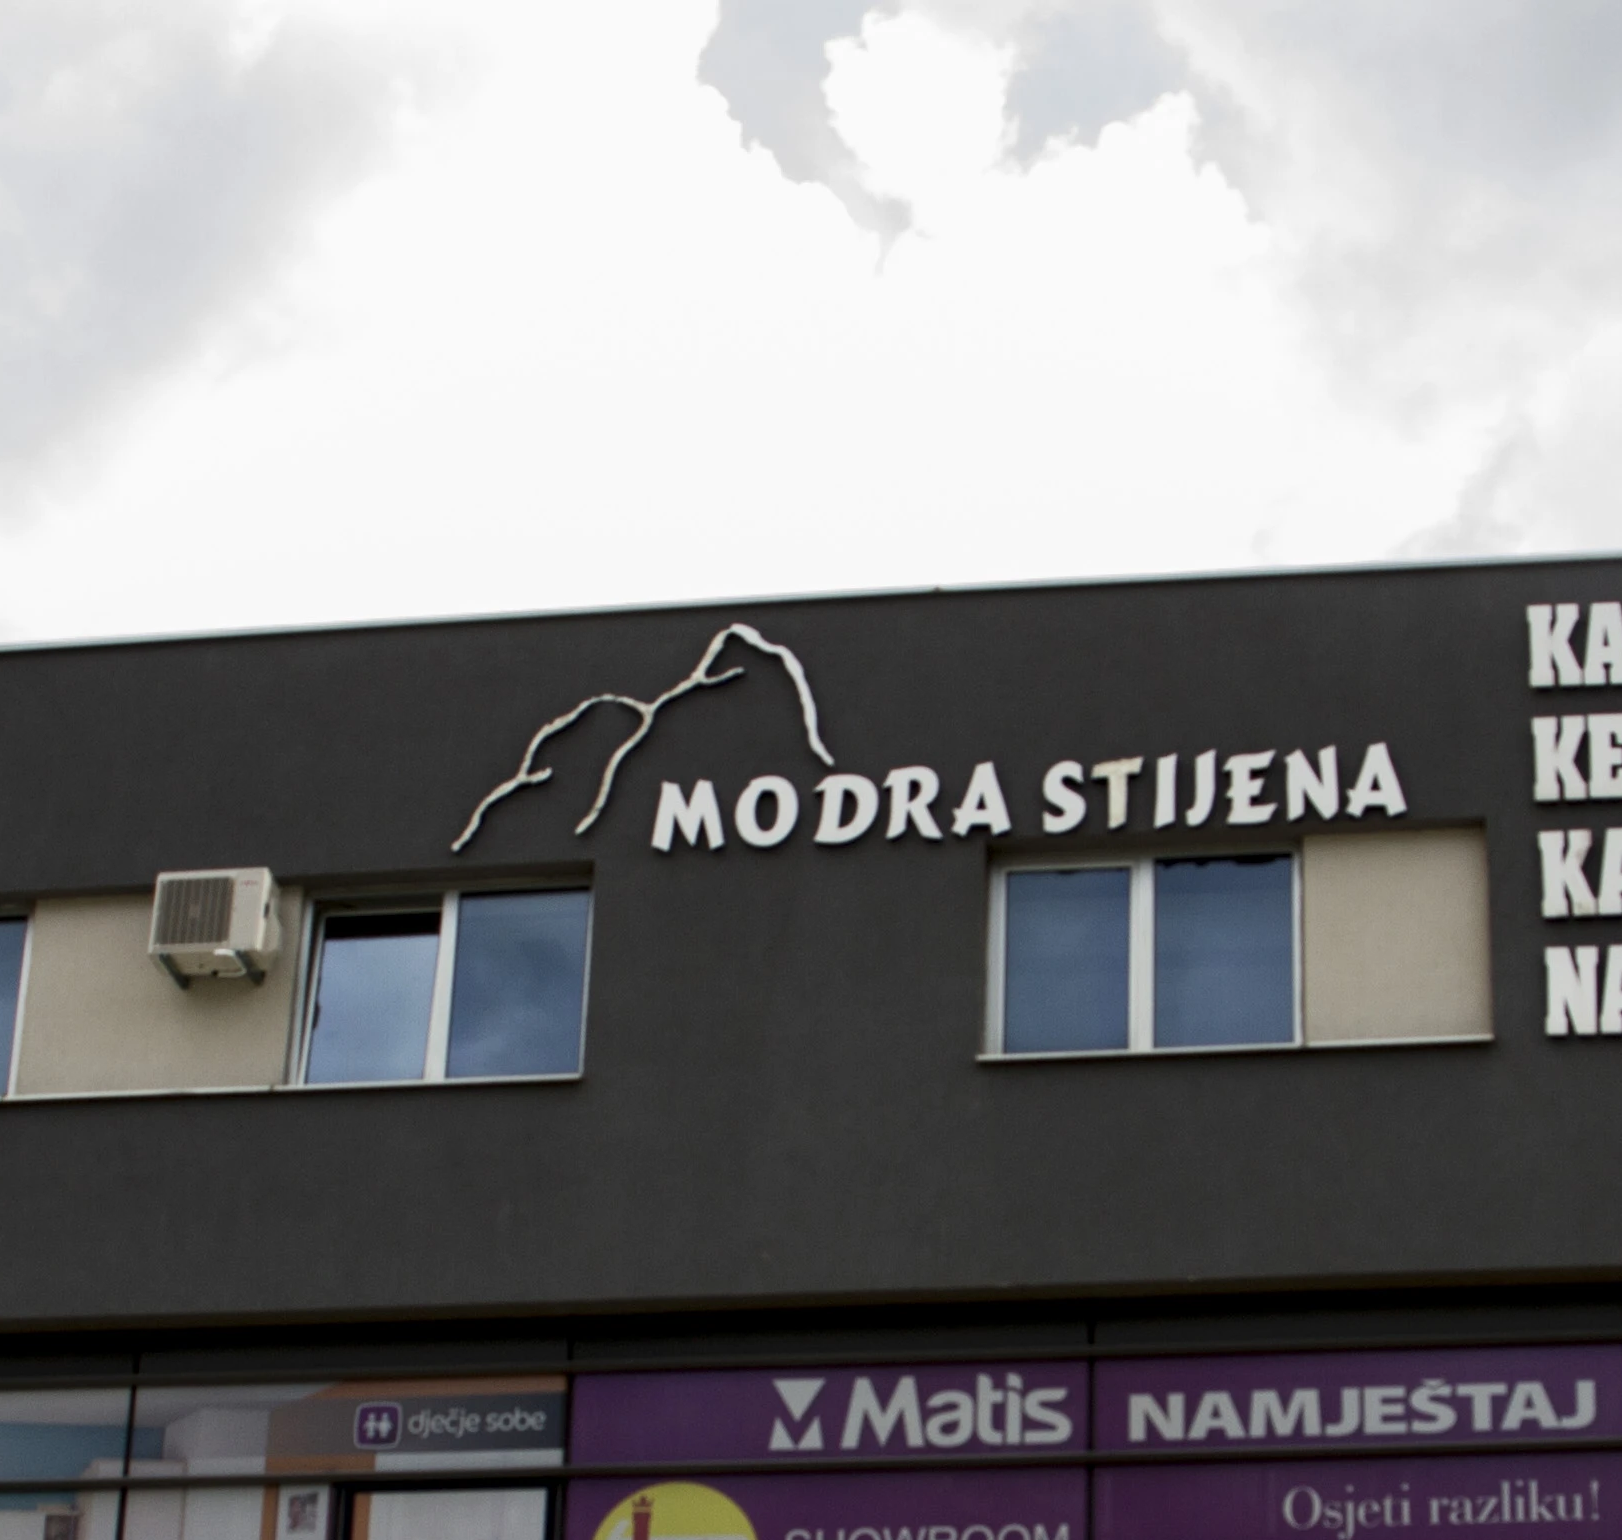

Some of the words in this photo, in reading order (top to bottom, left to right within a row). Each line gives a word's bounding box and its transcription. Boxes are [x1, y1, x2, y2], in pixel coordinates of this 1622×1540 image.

[650, 762, 1012, 853] MODRA
[1040, 740, 1408, 835] STIJENA
[407, 1406, 481, 1439] dječje
[485, 1405, 547, 1432] sobe
[840, 1372, 1074, 1449] Matis
[1128, 1378, 1598, 1442] NAMJEŠTAJ
[1427, 1478, 1601, 1526] razliku!
